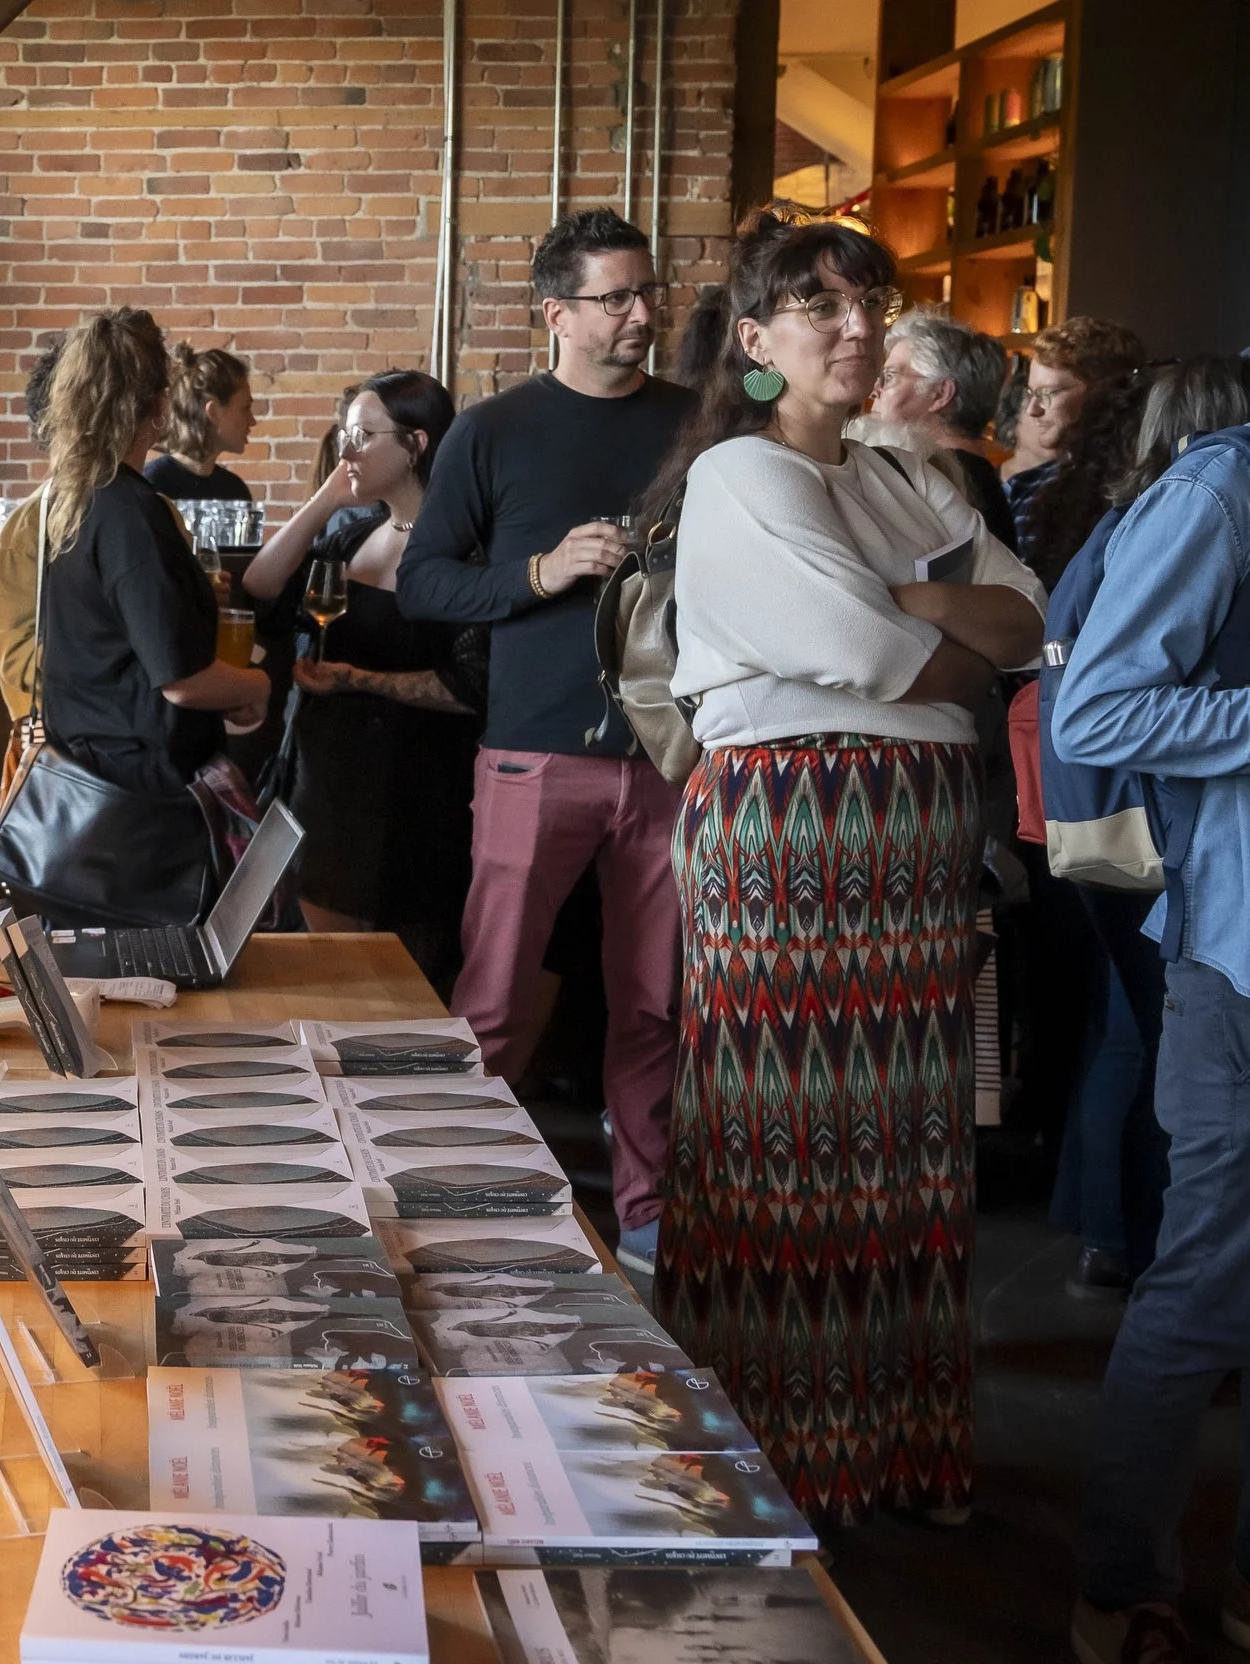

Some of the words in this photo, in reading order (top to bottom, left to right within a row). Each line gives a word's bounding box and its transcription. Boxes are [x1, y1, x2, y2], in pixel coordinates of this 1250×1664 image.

[456, 1393, 477, 1407] NOËL
[462, 1407, 486, 1431] MÉLANIE
[485, 1471, 506, 1488] NOËL
[492, 1489, 516, 1516] MÉLANIE
